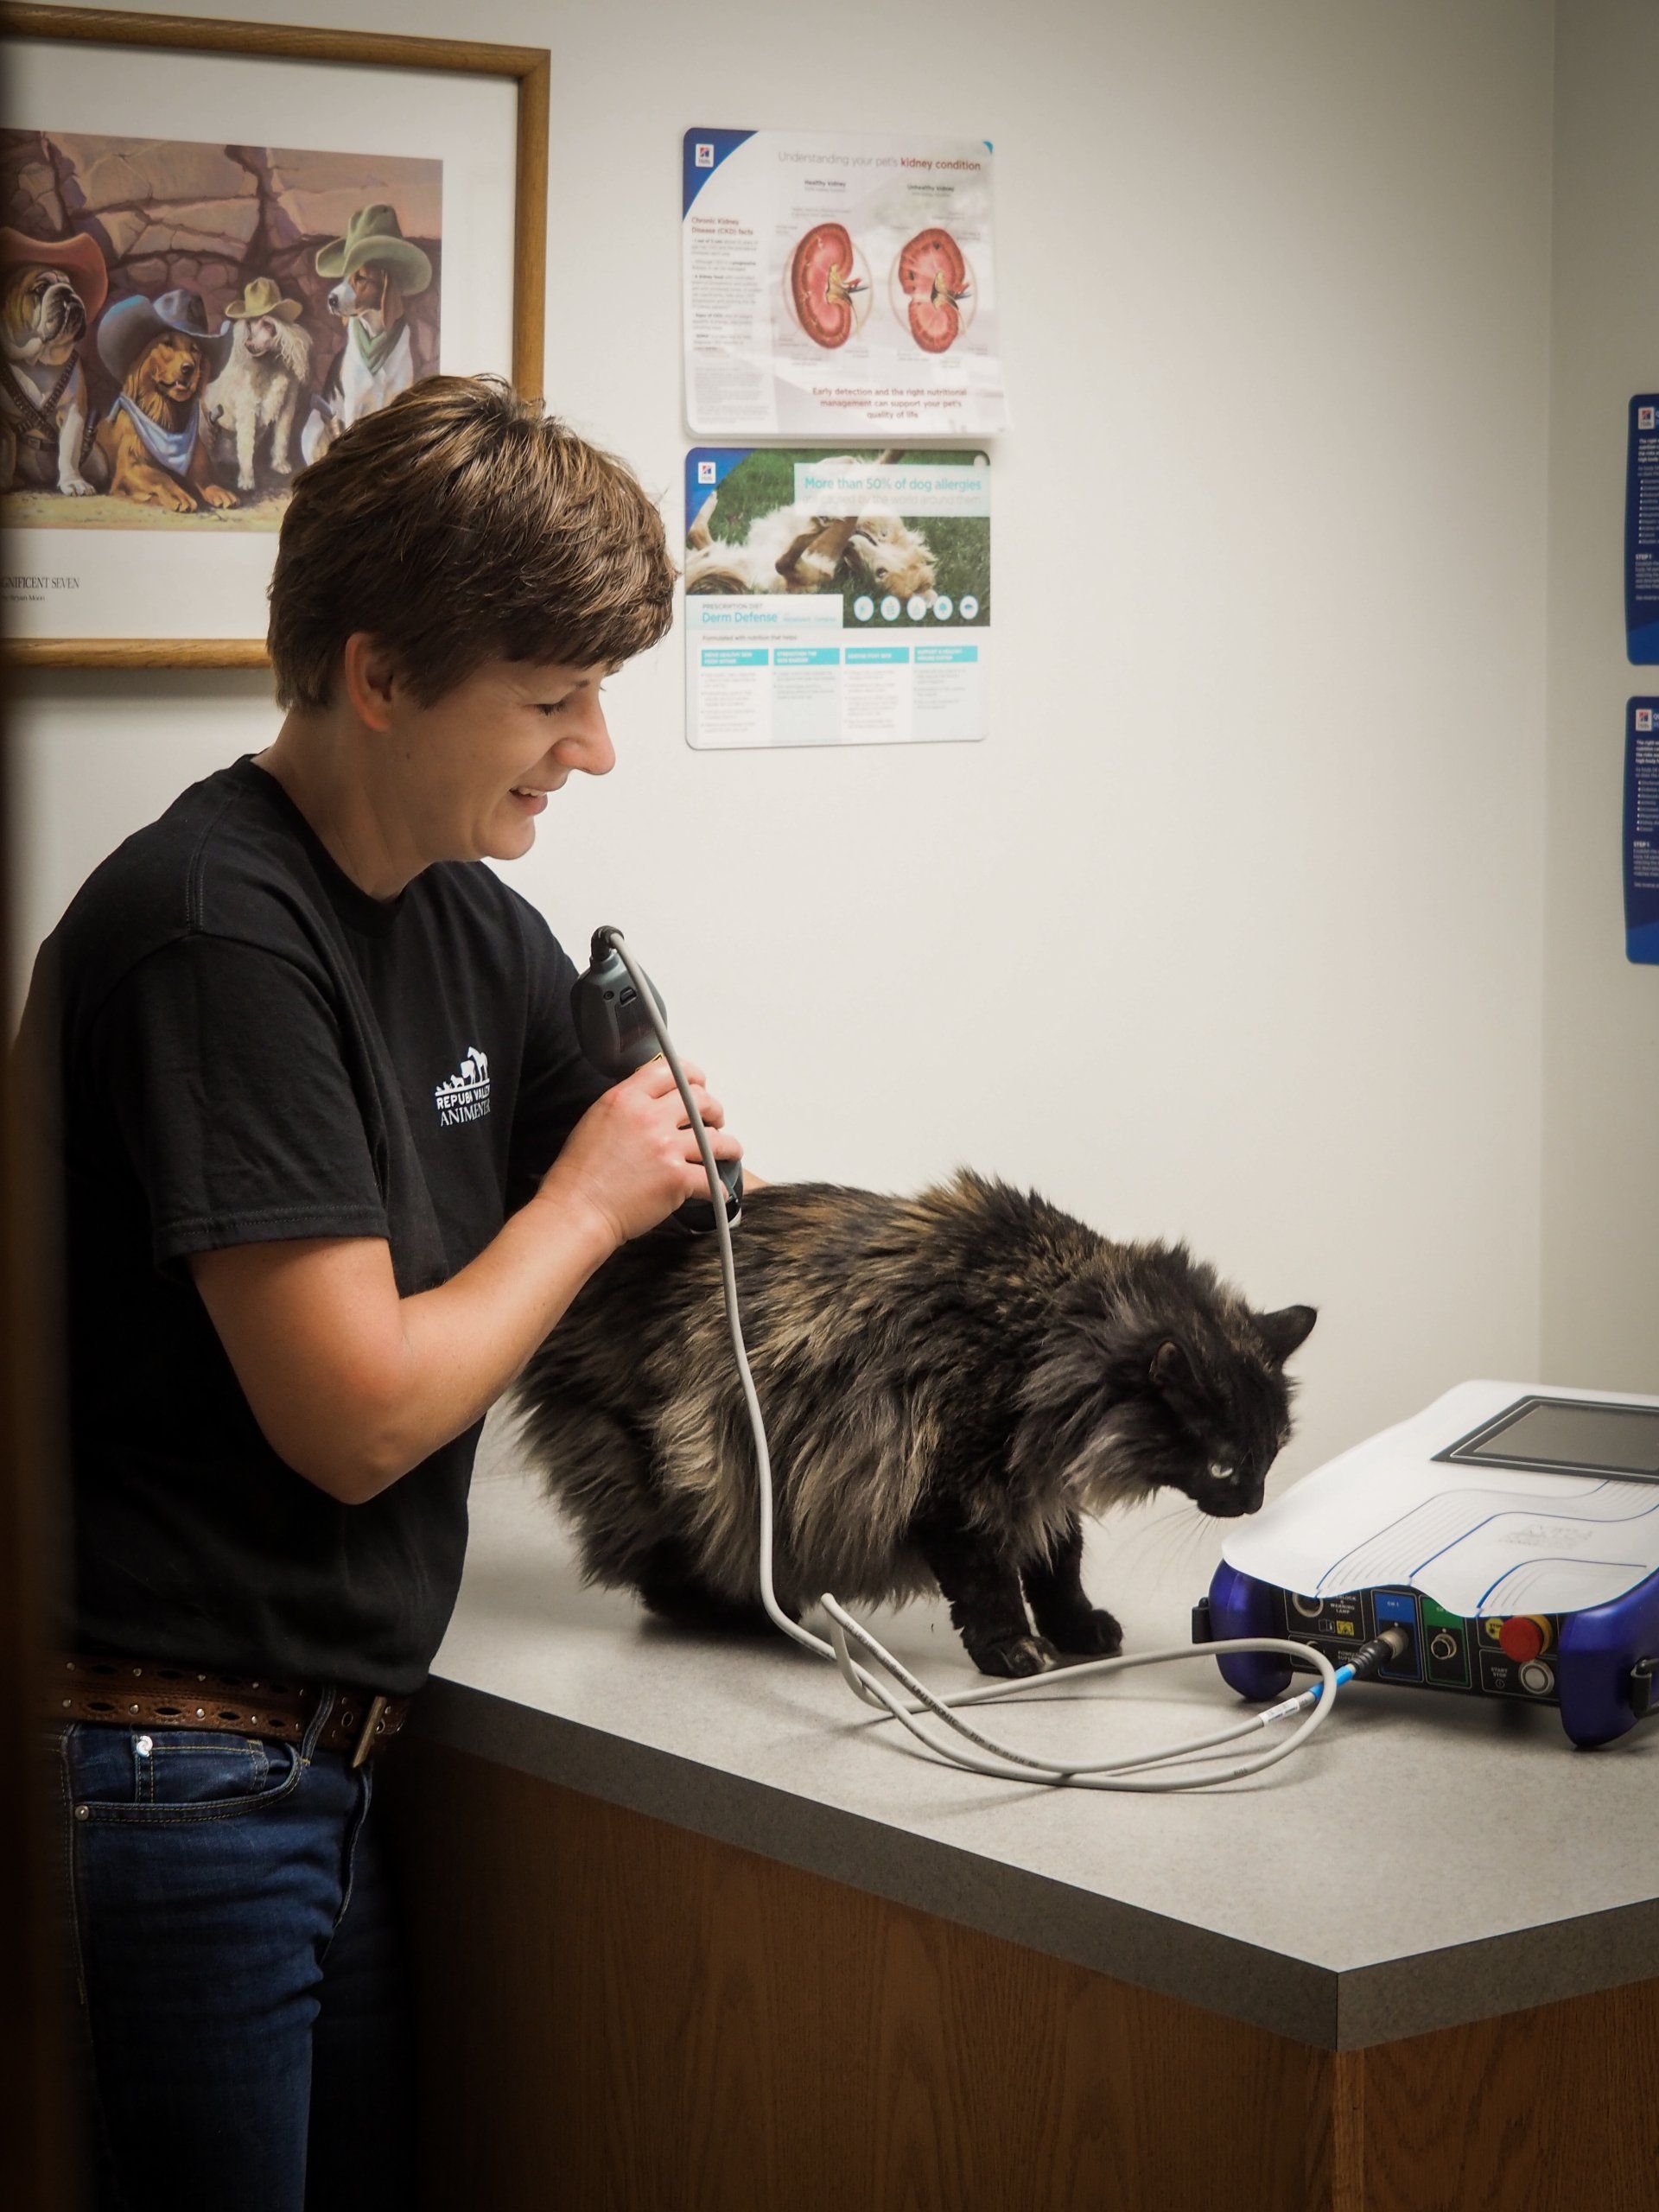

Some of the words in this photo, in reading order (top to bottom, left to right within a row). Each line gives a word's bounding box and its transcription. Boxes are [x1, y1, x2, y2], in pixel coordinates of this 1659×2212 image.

[778, 151, 849, 167] Understanding
[852, 156, 873, 167] your
[900, 157, 932, 171] kidney
[936, 160, 982, 171] condition
[812, 388, 832, 397] Early
[906, 388, 925, 397] right
[820, 400, 872, 409] management
[890, 400, 920, 409] support
[867, 411, 893, 420] quality
[804, 478, 835, 489] More
[837, 478, 862, 489] than
[866, 478, 891, 489] 50%
[894, 479, 906, 489] of
[909, 478, 932, 492] dog
[935, 478, 982, 492] allergies
[52, 577, 80, 589] SEVEN
[702, 613, 732, 623] Derm
[734, 612, 778, 623] Defense
